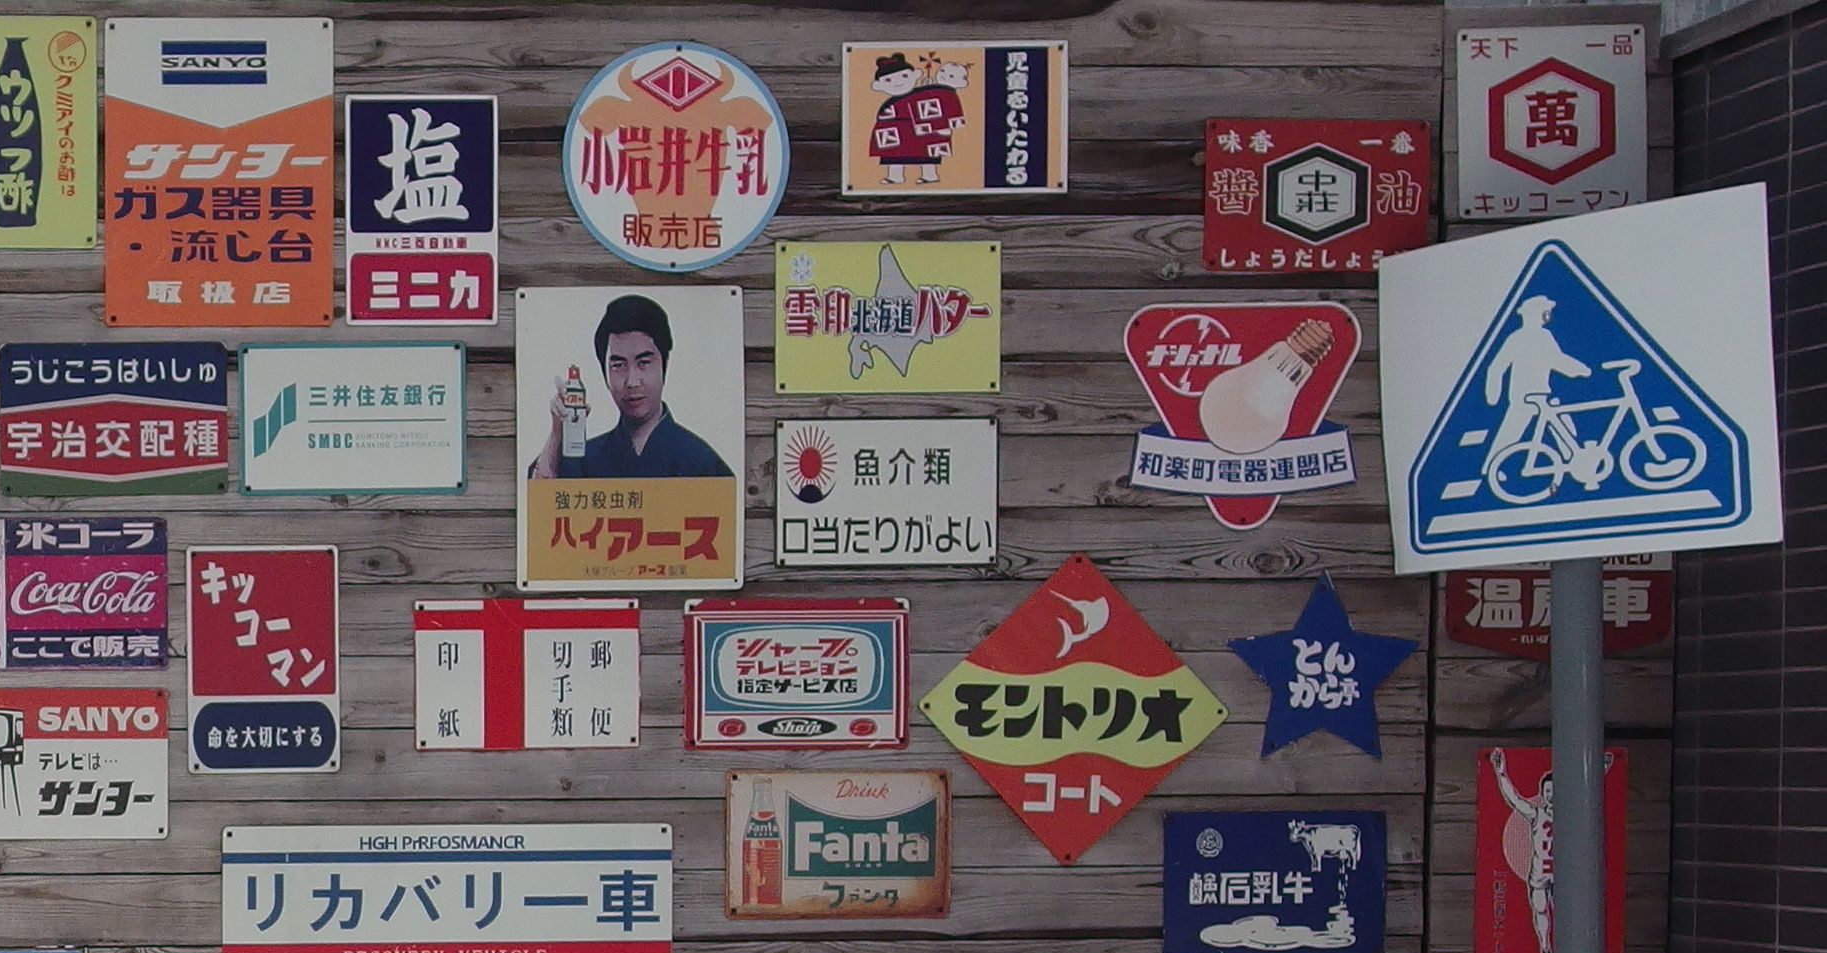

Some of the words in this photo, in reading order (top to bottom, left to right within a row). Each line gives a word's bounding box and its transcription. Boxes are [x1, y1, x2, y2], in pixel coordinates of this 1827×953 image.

[1471, 37, 1519, 59] 天下
[1585, 34, 1633, 55] 一品
[162, 56, 267, 69] SANYO
[1005, 52, 1029, 185] 児童をいたわる
[1525, 90, 1579, 148] 萬
[1218, 129, 1275, 153] 味香
[1359, 130, 1416, 154] 一番
[123, 143, 329, 180] サンヨー
[373, 107, 470, 223] 塩
[581, 126, 769, 196] 小岩井牛乳
[114, 186, 316, 221] ガス器具
[1474, 190, 1629, 214] キッコーマン
[623, 212, 723, 249] 販売店
[147, 280, 291, 304] 取扱店
[369, 269, 480, 310] ミニカ
[783, 286, 993, 338] 雪印北海道バター
[1146, 343, 1243, 367] ナショナル
[10, 357, 218, 386] うじこうはいしゅ
[308, 383, 447, 408] 三井住友銀行
[6, 420, 220, 460] 宇治交配種
[308, 432, 353, 449] SMBC
[853, 447, 951, 486] 魚介類
[1137, 449, 1348, 483] 和楽町電器連盟店
[555, 490, 644, 511] 強力殺虫剤
[16, 522, 156, 550] 氷コーラ
[550, 516, 720, 562] ハイアース
[782, 515, 992, 555] 口当たりがよい
[12, 635, 159, 660] ここで販売
[736, 637, 859, 658] シャープ
[736, 660, 858, 676] テレビジョン
[551, 640, 573, 738] 切手類
[736, 678, 858, 694] 指定サービス店
[38, 706, 160, 732] SANYO
[773, 719, 823, 736] Sharp
[954, 682, 1194, 744] モントリオ
[207, 726, 323, 750] 命を大切にする
[38, 780, 155, 816] サンヨー
[836, 778, 893, 800] Drink
[1023, 772, 1122, 814] コート
[359, 836, 397, 850] HGH
[794, 820, 930, 872] Fanta
[244, 869, 661, 933] リカバリー車
